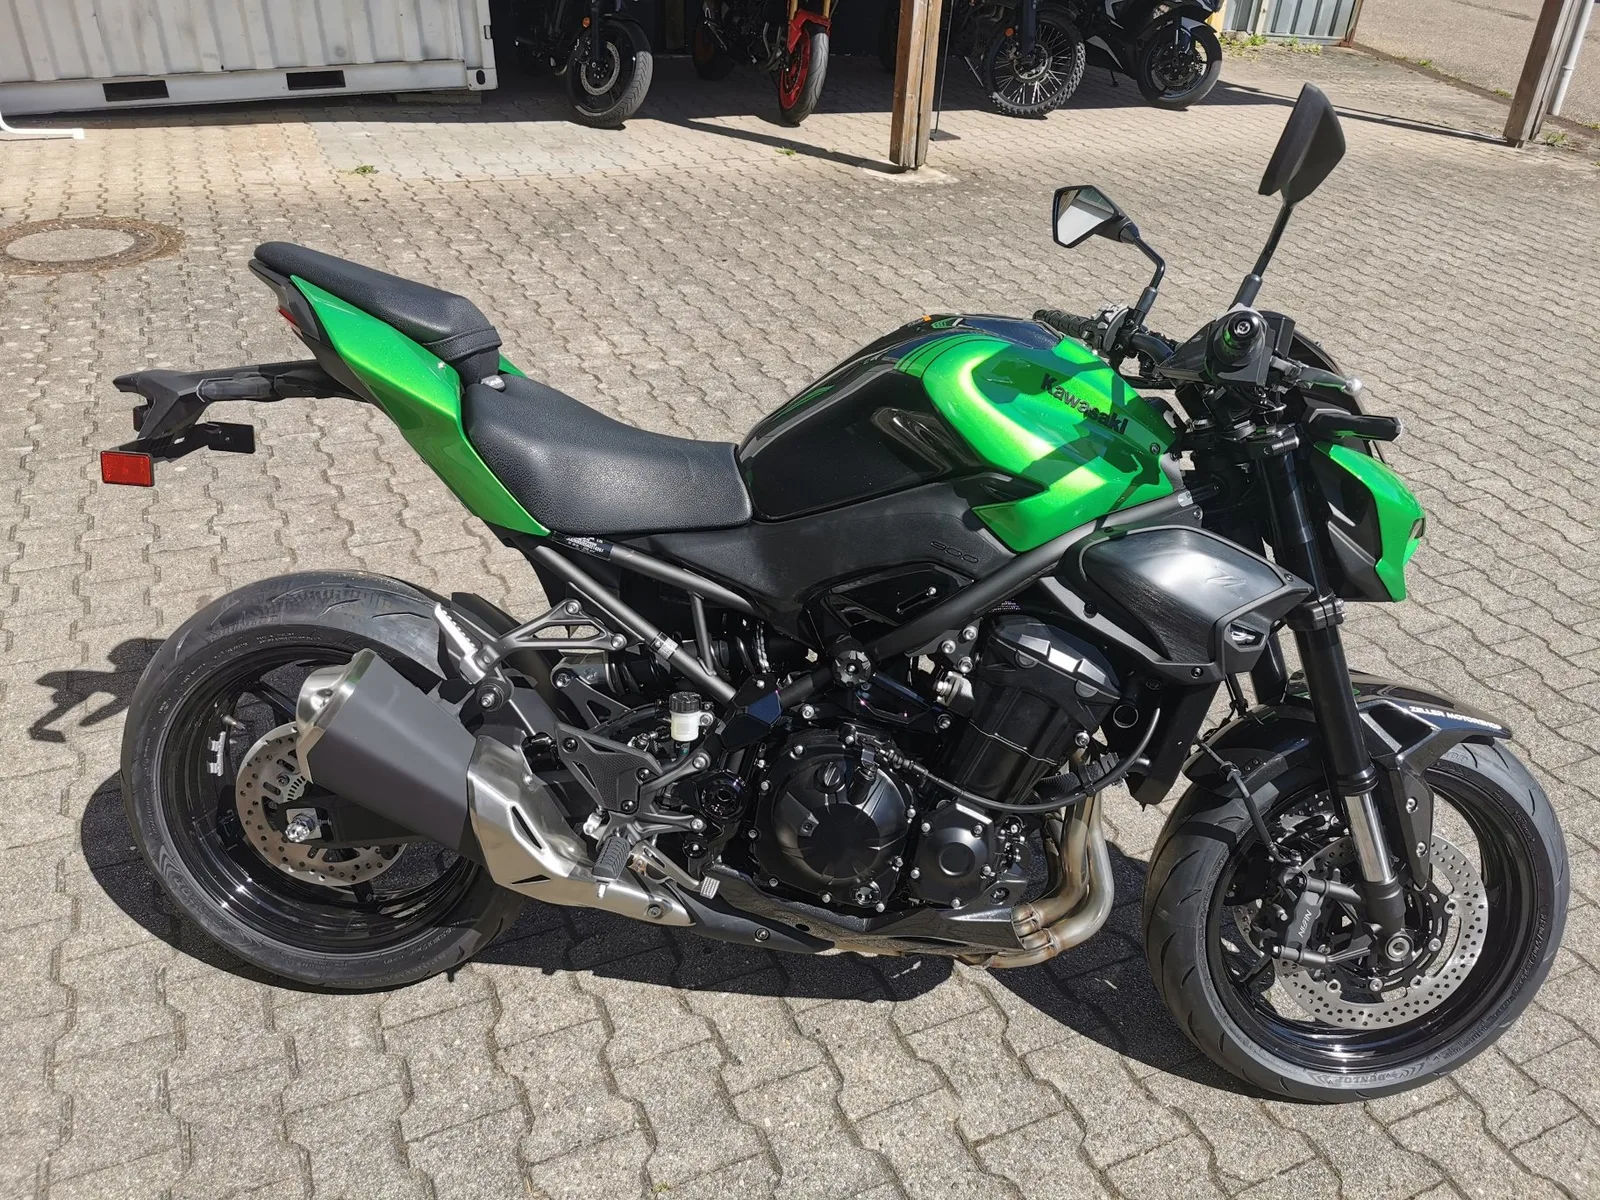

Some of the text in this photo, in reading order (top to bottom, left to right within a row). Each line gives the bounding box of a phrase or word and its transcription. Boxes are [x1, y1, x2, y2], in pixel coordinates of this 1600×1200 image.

[1040, 372, 1129, 435] Kawasaki
[930, 540, 979, 564] 900
[1409, 706, 1445, 717] ZELLER
